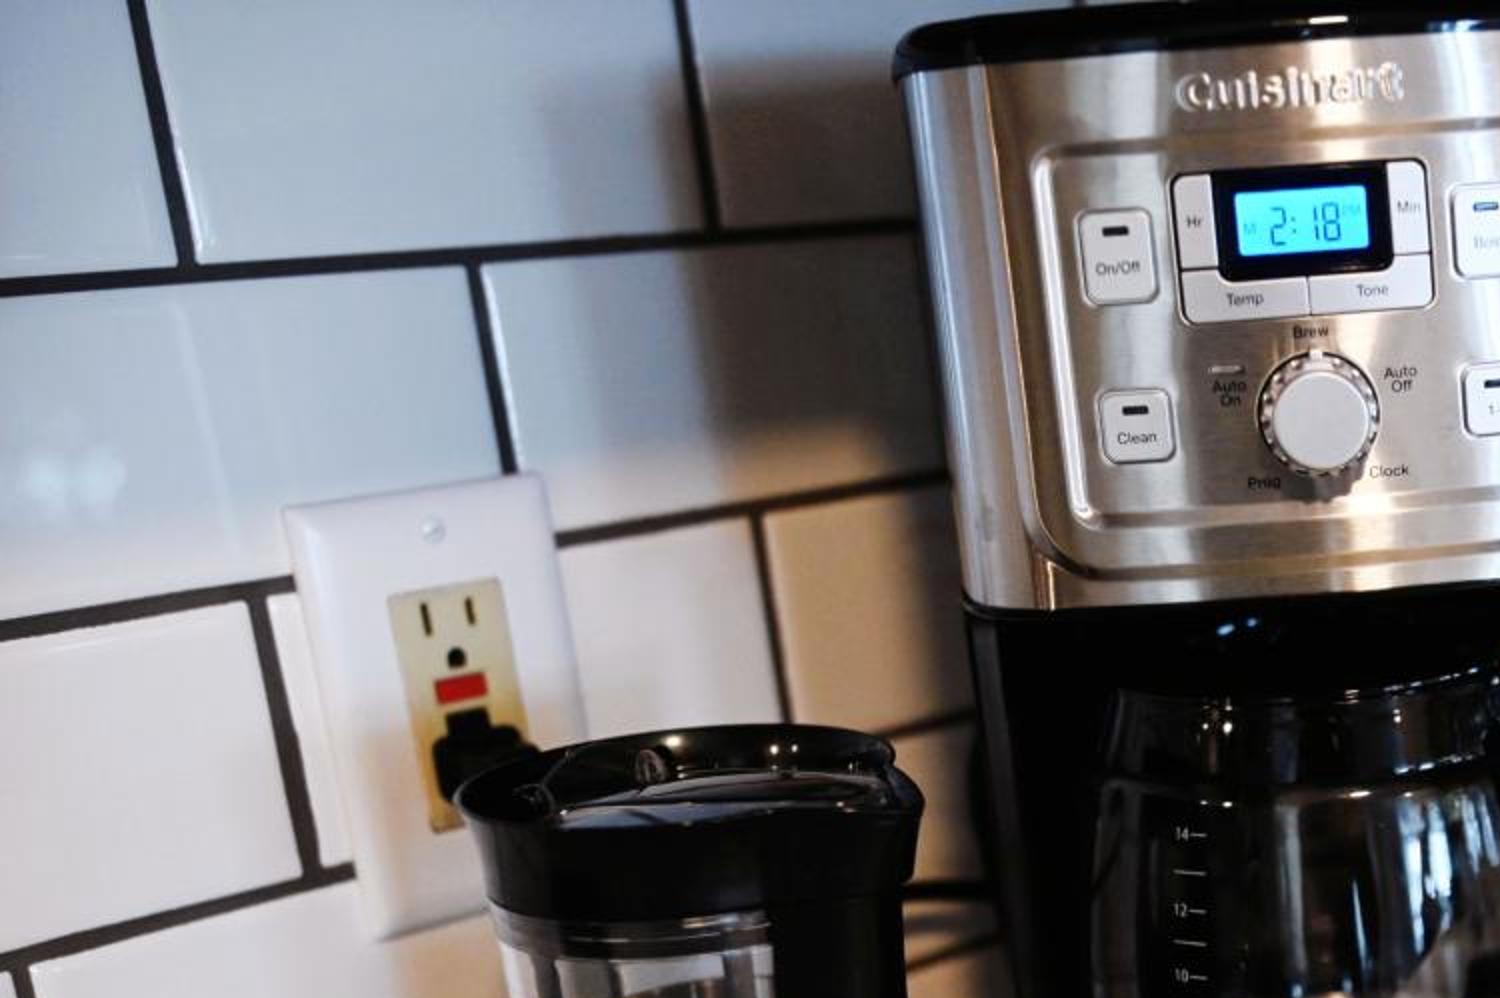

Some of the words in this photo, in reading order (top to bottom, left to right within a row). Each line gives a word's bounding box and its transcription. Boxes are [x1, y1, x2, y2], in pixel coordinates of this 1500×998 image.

[1175, 61, 1405, 112] Cuisinart
[1397, 199, 1421, 213] Min
[1186, 212, 1203, 229] Hr
[1269, 202, 1342, 247] 2:18
[1095, 258, 1141, 276] On/Off
[1356, 282, 1389, 298] Tone
[1227, 291, 1264, 307] Temp
[1293, 325, 1330, 338] Brew
[1384, 365, 1418, 380] Auto
[1213, 380, 1248, 394] Auto
[1391, 380, 1414, 393] Off
[1220, 394, 1242, 409] On
[1117, 431, 1157, 446] Clean
[1369, 463, 1409, 479] Clock
[1175, 827, 1188, 840] 14
[1174, 903, 1188, 917] 12
[1175, 968, 1189, 982] 10
